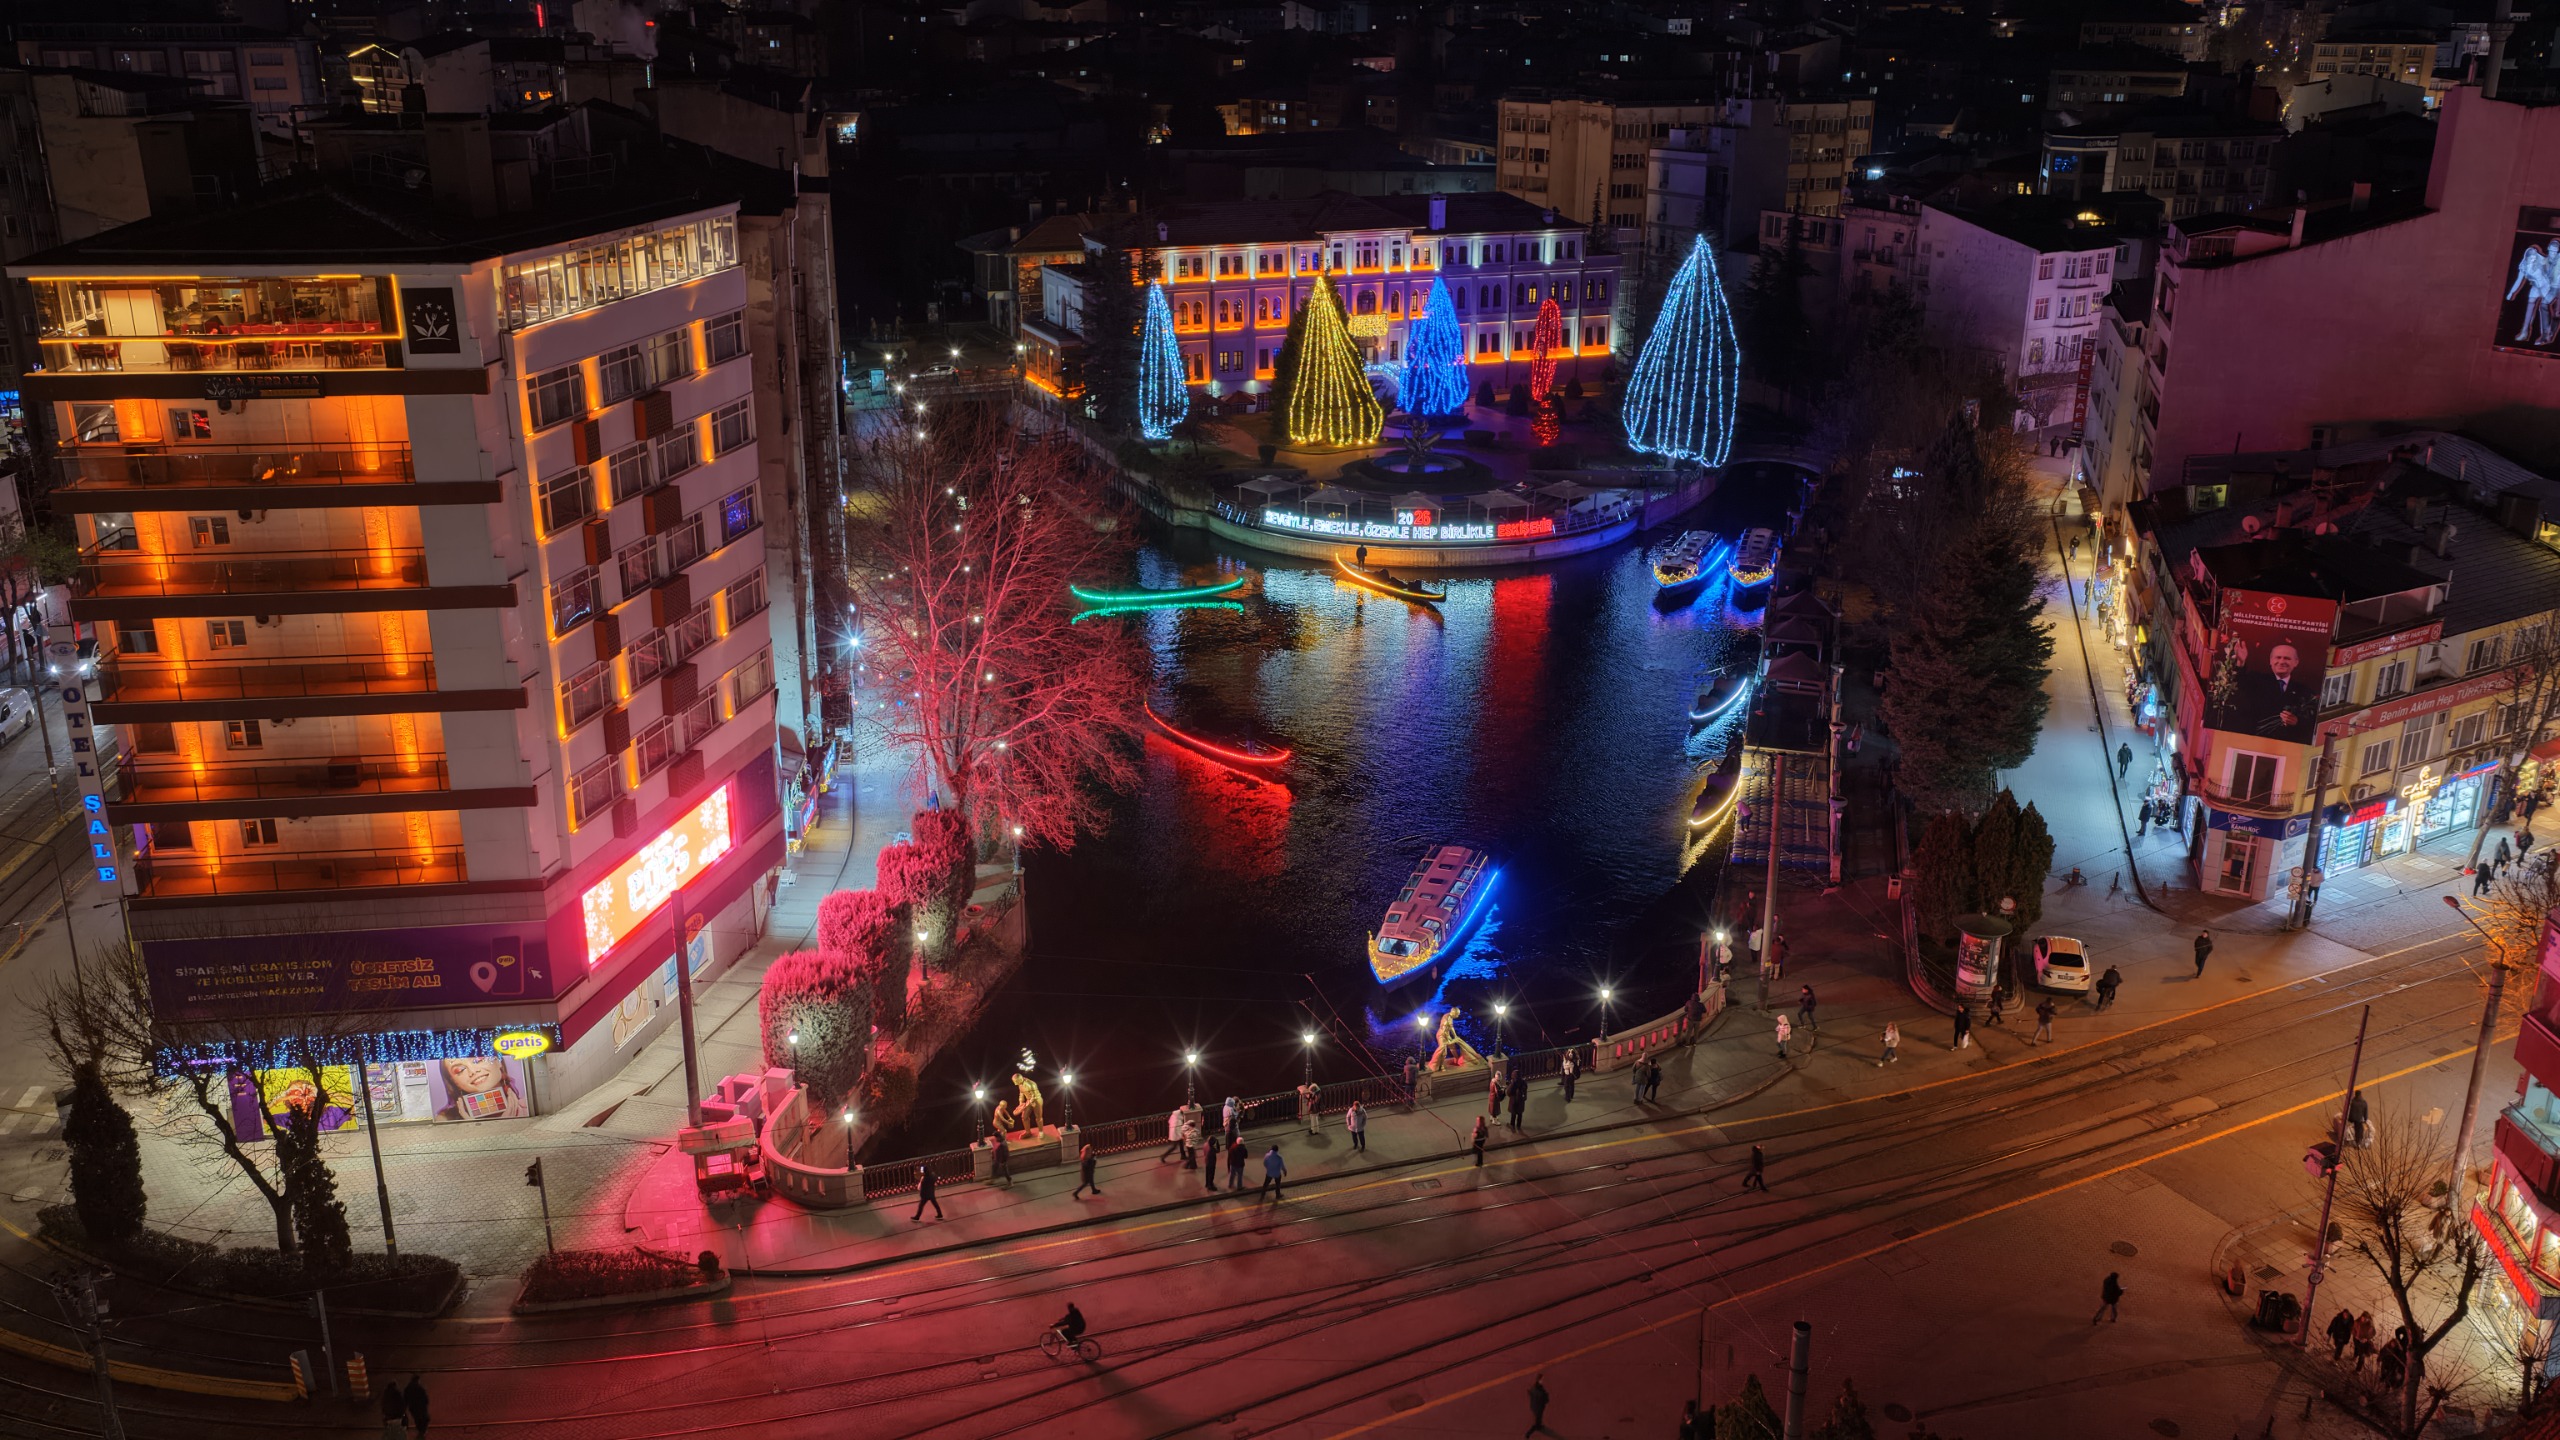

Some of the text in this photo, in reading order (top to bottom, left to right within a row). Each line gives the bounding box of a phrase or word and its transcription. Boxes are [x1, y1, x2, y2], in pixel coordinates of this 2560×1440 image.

[2079, 344, 2093, 381] OTEL
[248, 375, 320, 387] TERRAZZA
[2073, 392, 2086, 430] CAFE
[1398, 510, 1432, 526] 2026
[1412, 525, 1438, 540] HEP
[1440, 523, 1494, 540] BİRLİKLE
[1497, 516, 1553, 538] ESKİŞEHİR
[2233, 617, 2329, 634] ODUNPAZARI İLÇE BAŞKANLIĞI
[2270, 616, 2302, 625] HAREKET
[2302, 619, 2329, 628] PARTİSİ
[2379, 704, 2409, 723] Benim
[2410, 698, 2436, 715] Aklım
[2436, 693, 2455, 709] Hep
[63, 686, 95, 777] OTEL
[83, 793, 118, 882] ŞALE
[347, 957, 442, 992] ÜCRETSİZ TESLİM AL!
[500, 1036, 543, 1051] gratis
